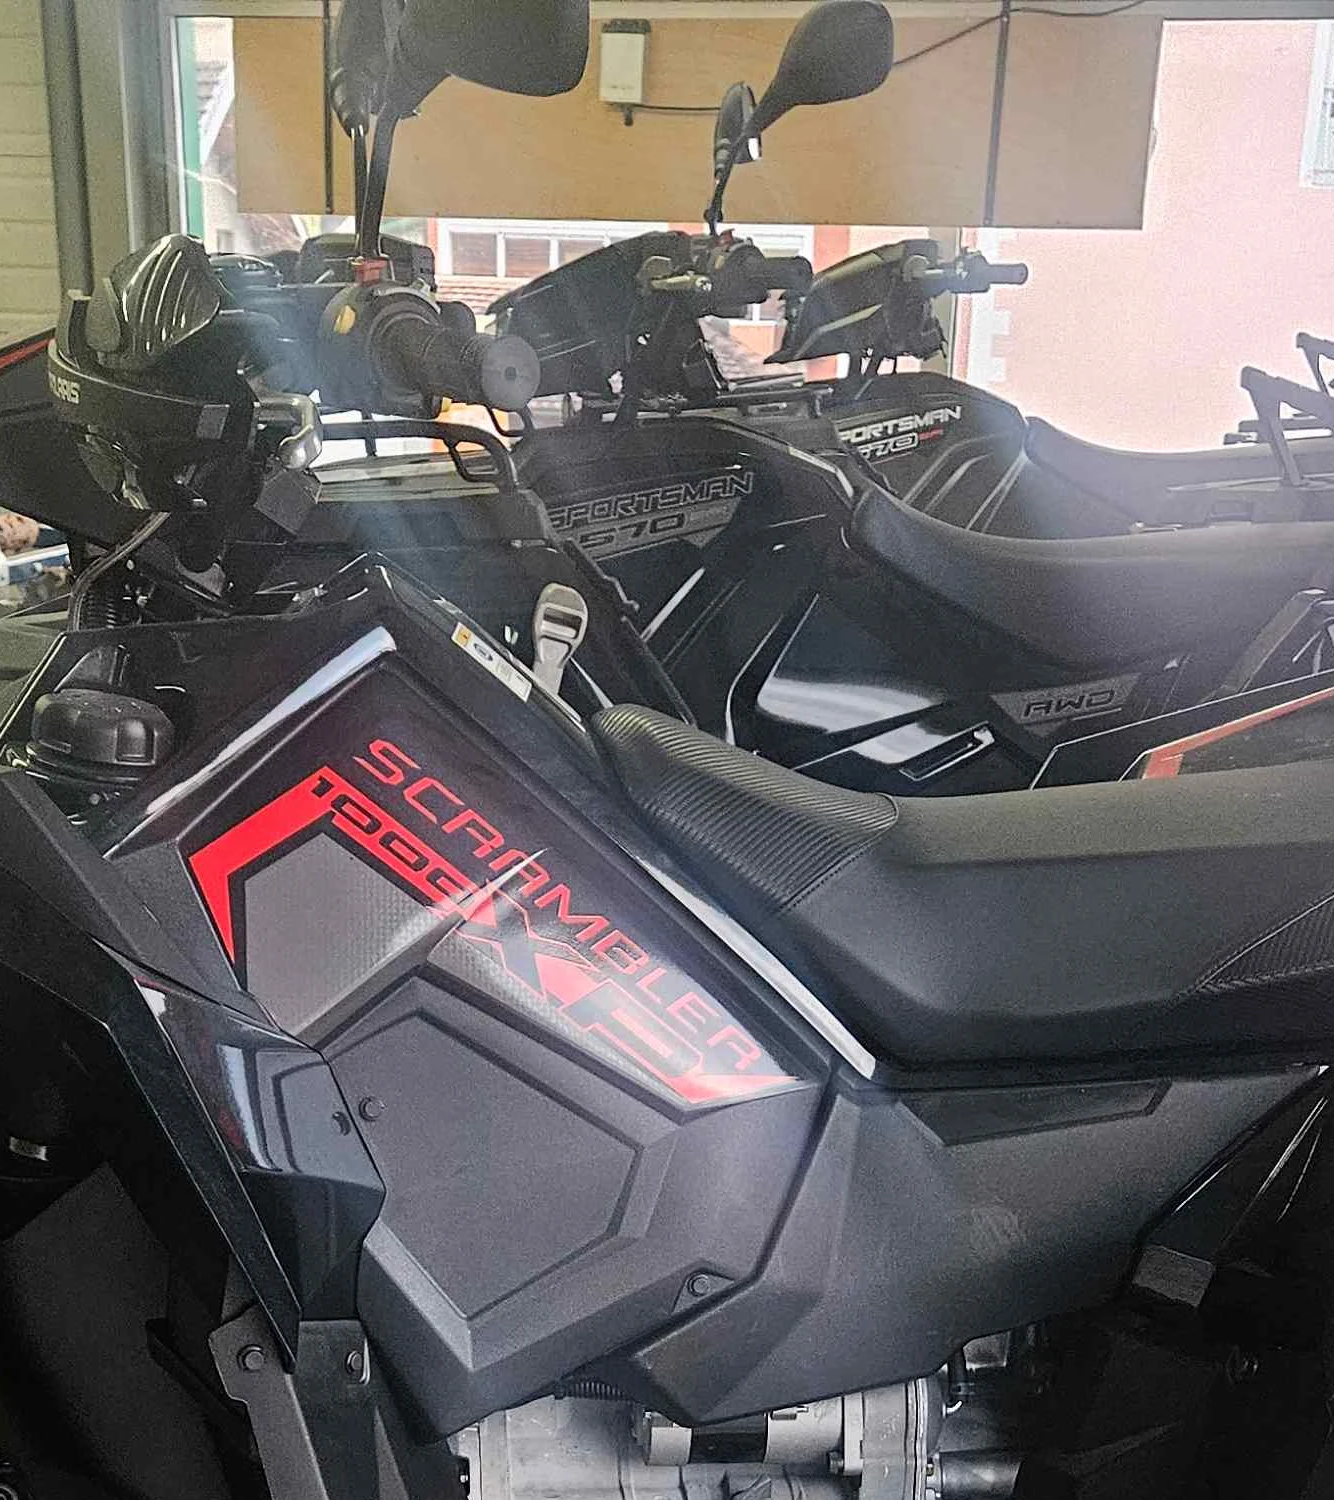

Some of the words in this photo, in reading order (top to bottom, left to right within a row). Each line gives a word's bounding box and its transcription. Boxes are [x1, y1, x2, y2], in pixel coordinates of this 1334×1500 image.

[838, 405, 962, 443] PORTSMAN
[546, 471, 755, 530] SPORTSMAN
[578, 512, 688, 550] 570
[1021, 688, 1117, 719] AWD
[310, 774, 470, 902] 1000
[354, 738, 763, 1071] SCRAMBLER
